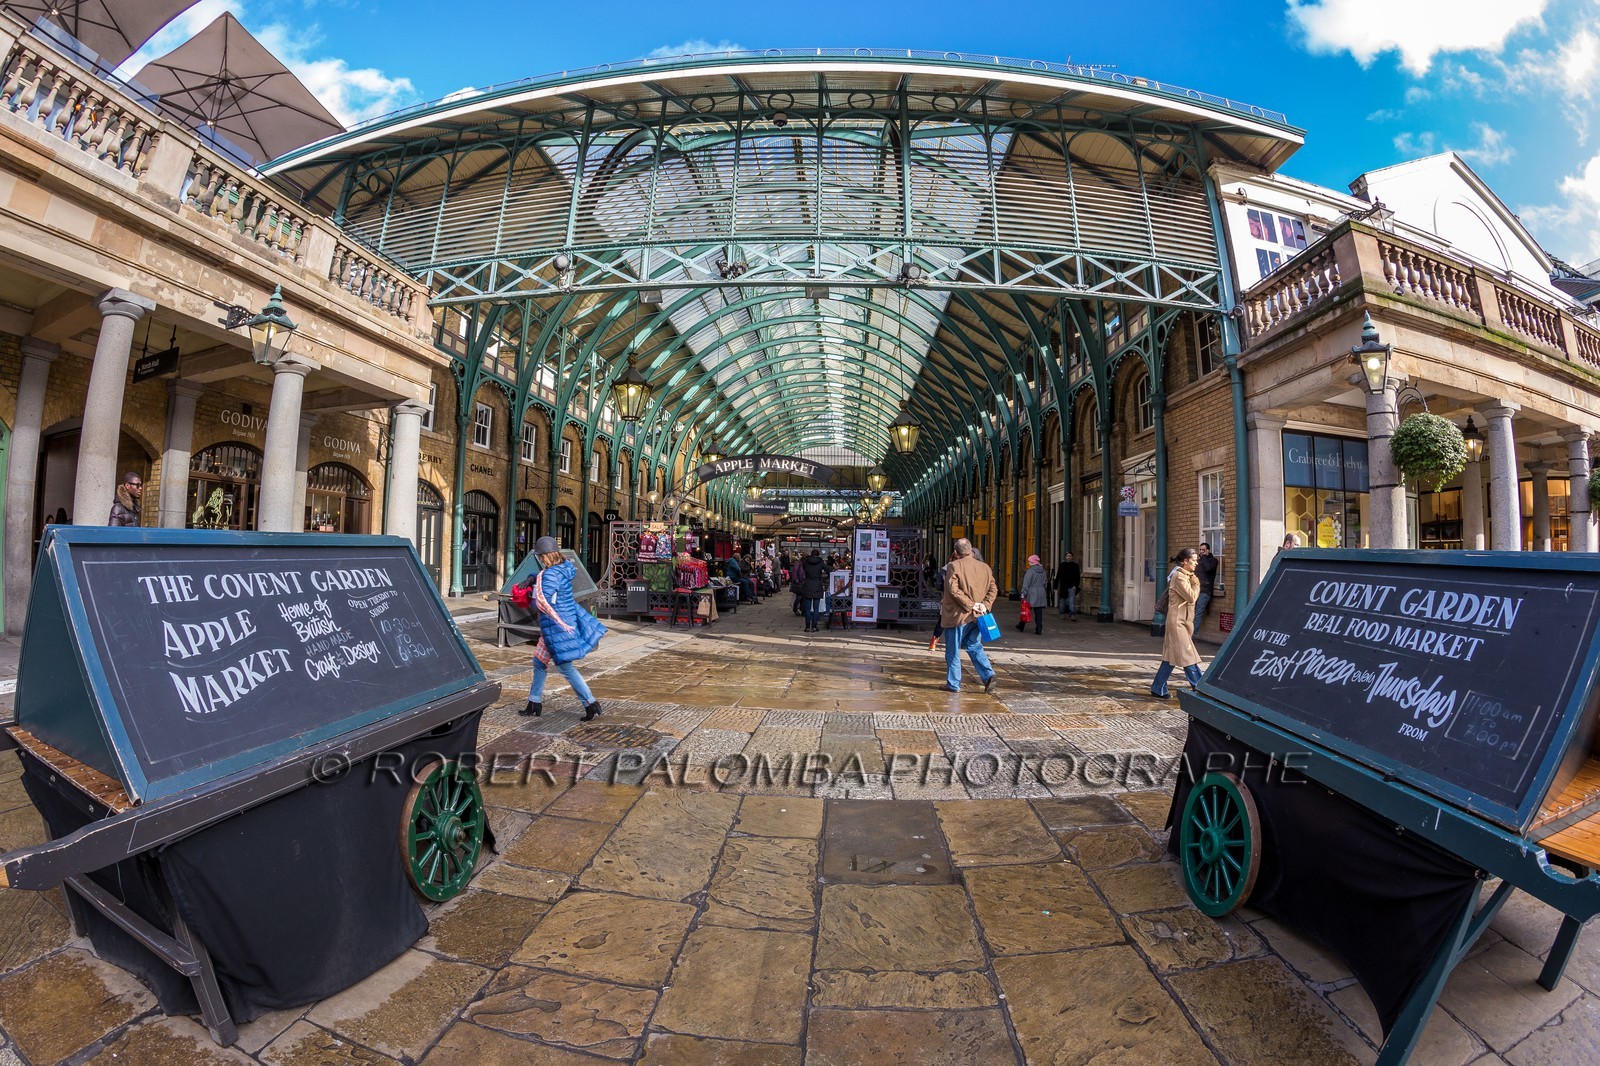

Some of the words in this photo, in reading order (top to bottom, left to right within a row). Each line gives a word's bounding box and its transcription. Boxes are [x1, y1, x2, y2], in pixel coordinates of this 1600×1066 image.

[221, 409, 268, 432] GODIVA
[323, 436, 361, 454] GODIVA
[418, 452, 443, 465] BERRY
[715, 458, 754, 474] APPLE
[760, 457, 818, 475] MARKET
[1288, 447, 1327, 466] Crabtree
[1328, 453, 1336, 467] &
[470, 463, 494, 477] CHANEL
[558, 486, 574, 496] CHANEL
[809, 516, 834, 525] MARKET
[138, 574, 199, 604] THE
[203, 571, 304, 600] COVENT
[310, 568, 393, 592] GARDEN
[879, 591, 899, 599] LITTER
[277, 602, 314, 623] Home
[313, 594, 333, 619] of
[347, 598, 368, 609] OPEN
[366, 591, 391, 607] TUESDAY
[389, 589, 399, 598] TO
[1308, 580, 1396, 612] COVENT
[1400, 588, 1524, 630] GARDEN
[368, 602, 391, 618] SUNDAY
[162, 608, 257, 659] APPLE
[292, 615, 342, 643] British
[396, 633, 412, 645] TO
[1253, 628, 1269, 641] ON
[1267, 631, 1291, 647] THE
[1303, 612, 1343, 636] REAL
[1344, 618, 1391, 642] FOOD
[1389, 626, 1485, 662] MARKET
[305, 638, 330, 657] HAND
[331, 629, 355, 651] MADE
[304, 652, 342, 681] Craft
[340, 640, 382, 666] Design
[169, 648, 293, 714] MARKET
[1250, 649, 1299, 682] East
[1290, 648, 1354, 686] Piazza
[1351, 669, 1377, 692] every
[1366, 661, 1458, 728] Thursday
[1398, 722, 1429, 742] FROM
